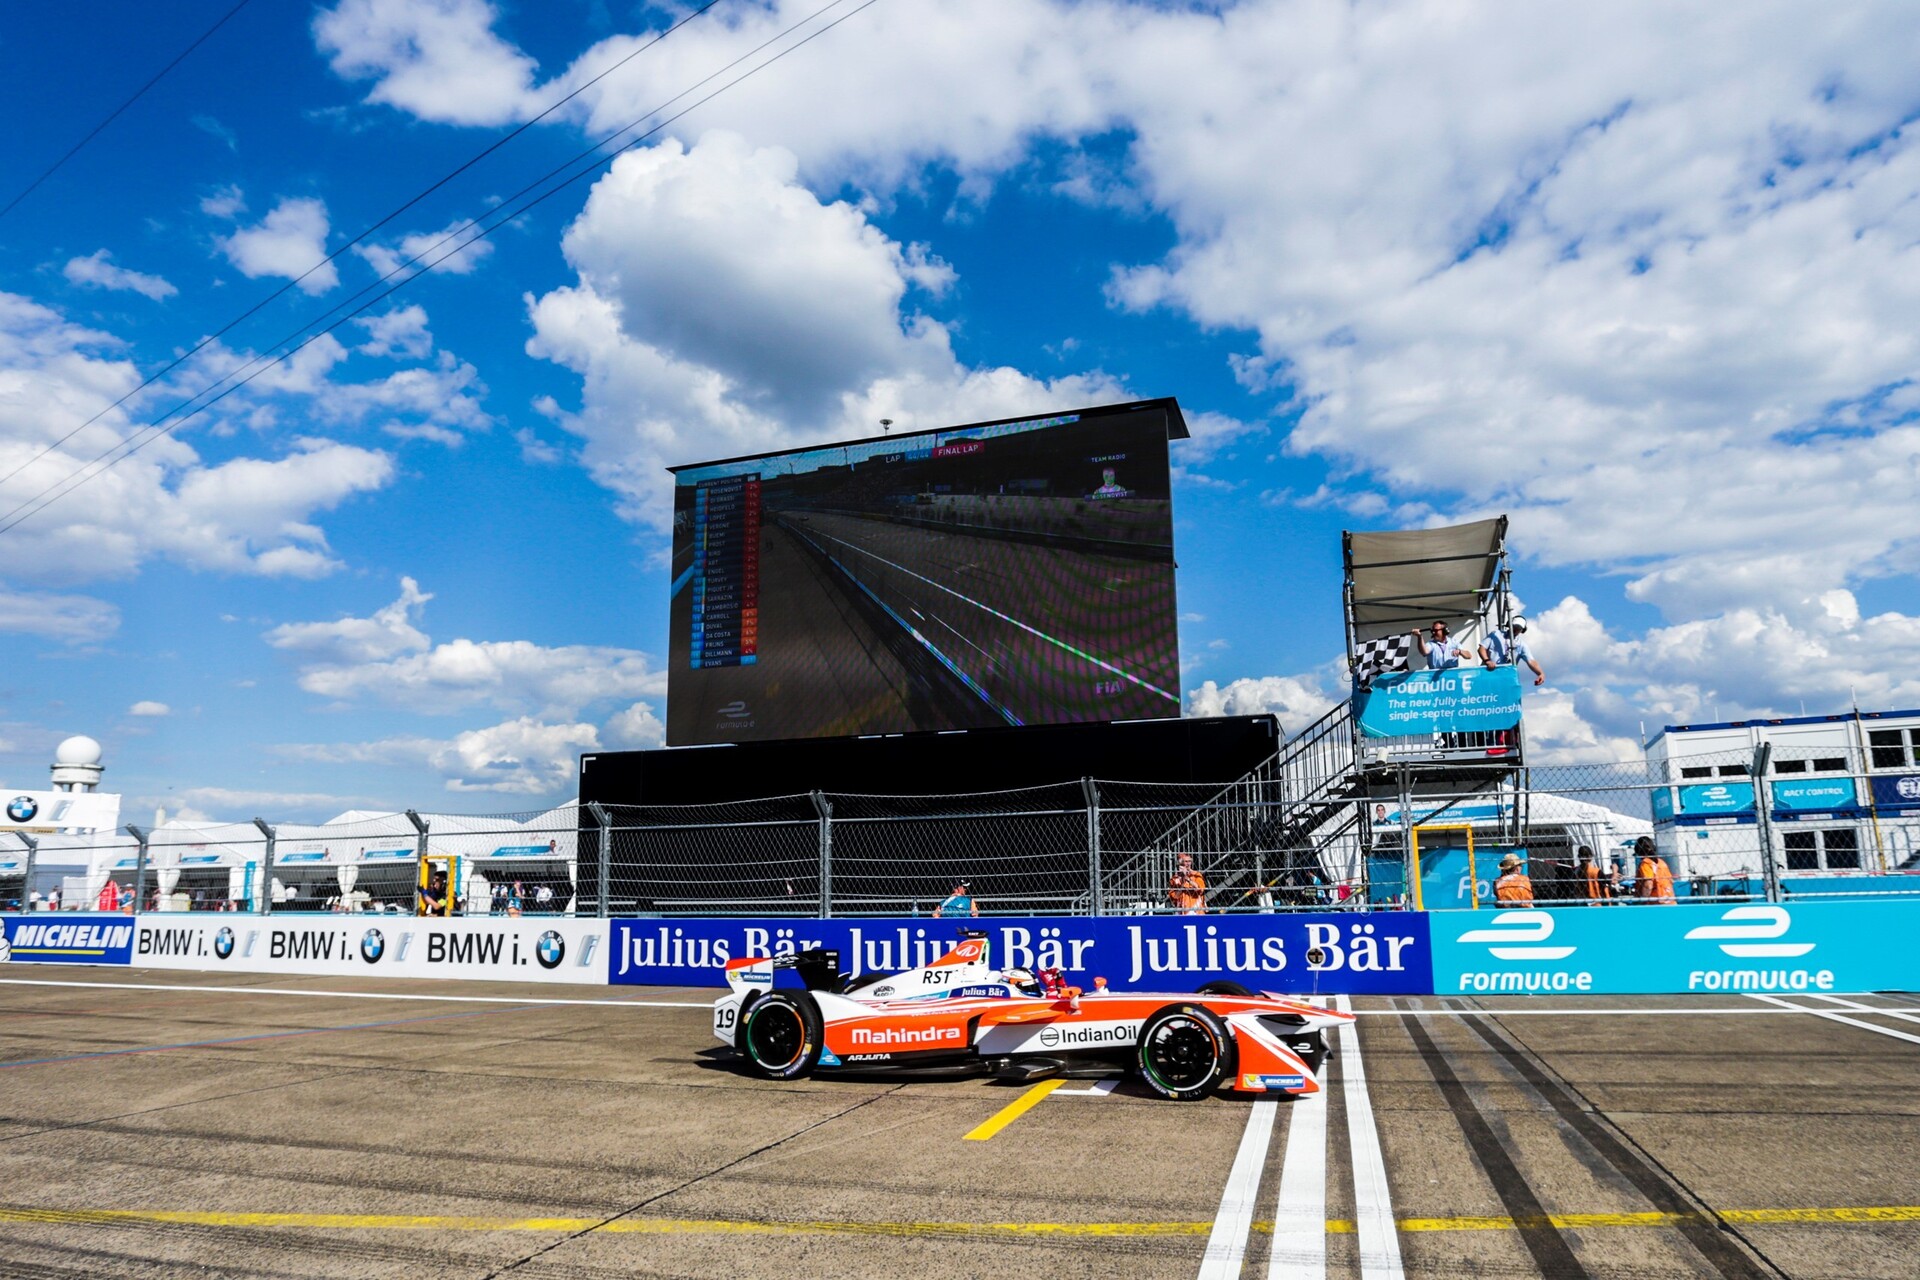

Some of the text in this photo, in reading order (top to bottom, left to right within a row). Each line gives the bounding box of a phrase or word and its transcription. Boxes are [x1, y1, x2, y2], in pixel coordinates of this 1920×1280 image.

[886, 455, 900, 463] LAP
[938, 448, 961, 456] FINAL
[963, 444, 978, 453] LAP
[1387, 675, 1472, 694] Formula E
[1388, 693, 1498, 708] The new fully-electric
[1389, 709, 1454, 722] single-seater
[12, 925, 132, 948] MICHELIN
[138, 928, 194, 954] BMW
[198, 930, 208, 956] i.
[270, 930, 334, 960] BMW
[340, 932, 352, 960] i.
[428, 932, 504, 964] BMW
[512, 934, 526, 965] i.
[618, 926, 730, 975] Julius
[1000, 926, 1095, 972] Bär
[1128, 924, 1415, 983] Julius Bär
[922, 971, 954, 984] RST
[962, 987, 1004, 998] Julius Bär
[716, 1008, 735, 1028] 19
[852, 1026, 960, 1044] Mahindra
[1062, 1026, 1138, 1044] IndianOil
[848, 1053, 891, 1062] ARJUNA
[1265, 1076, 1304, 1086] MICHELIN
